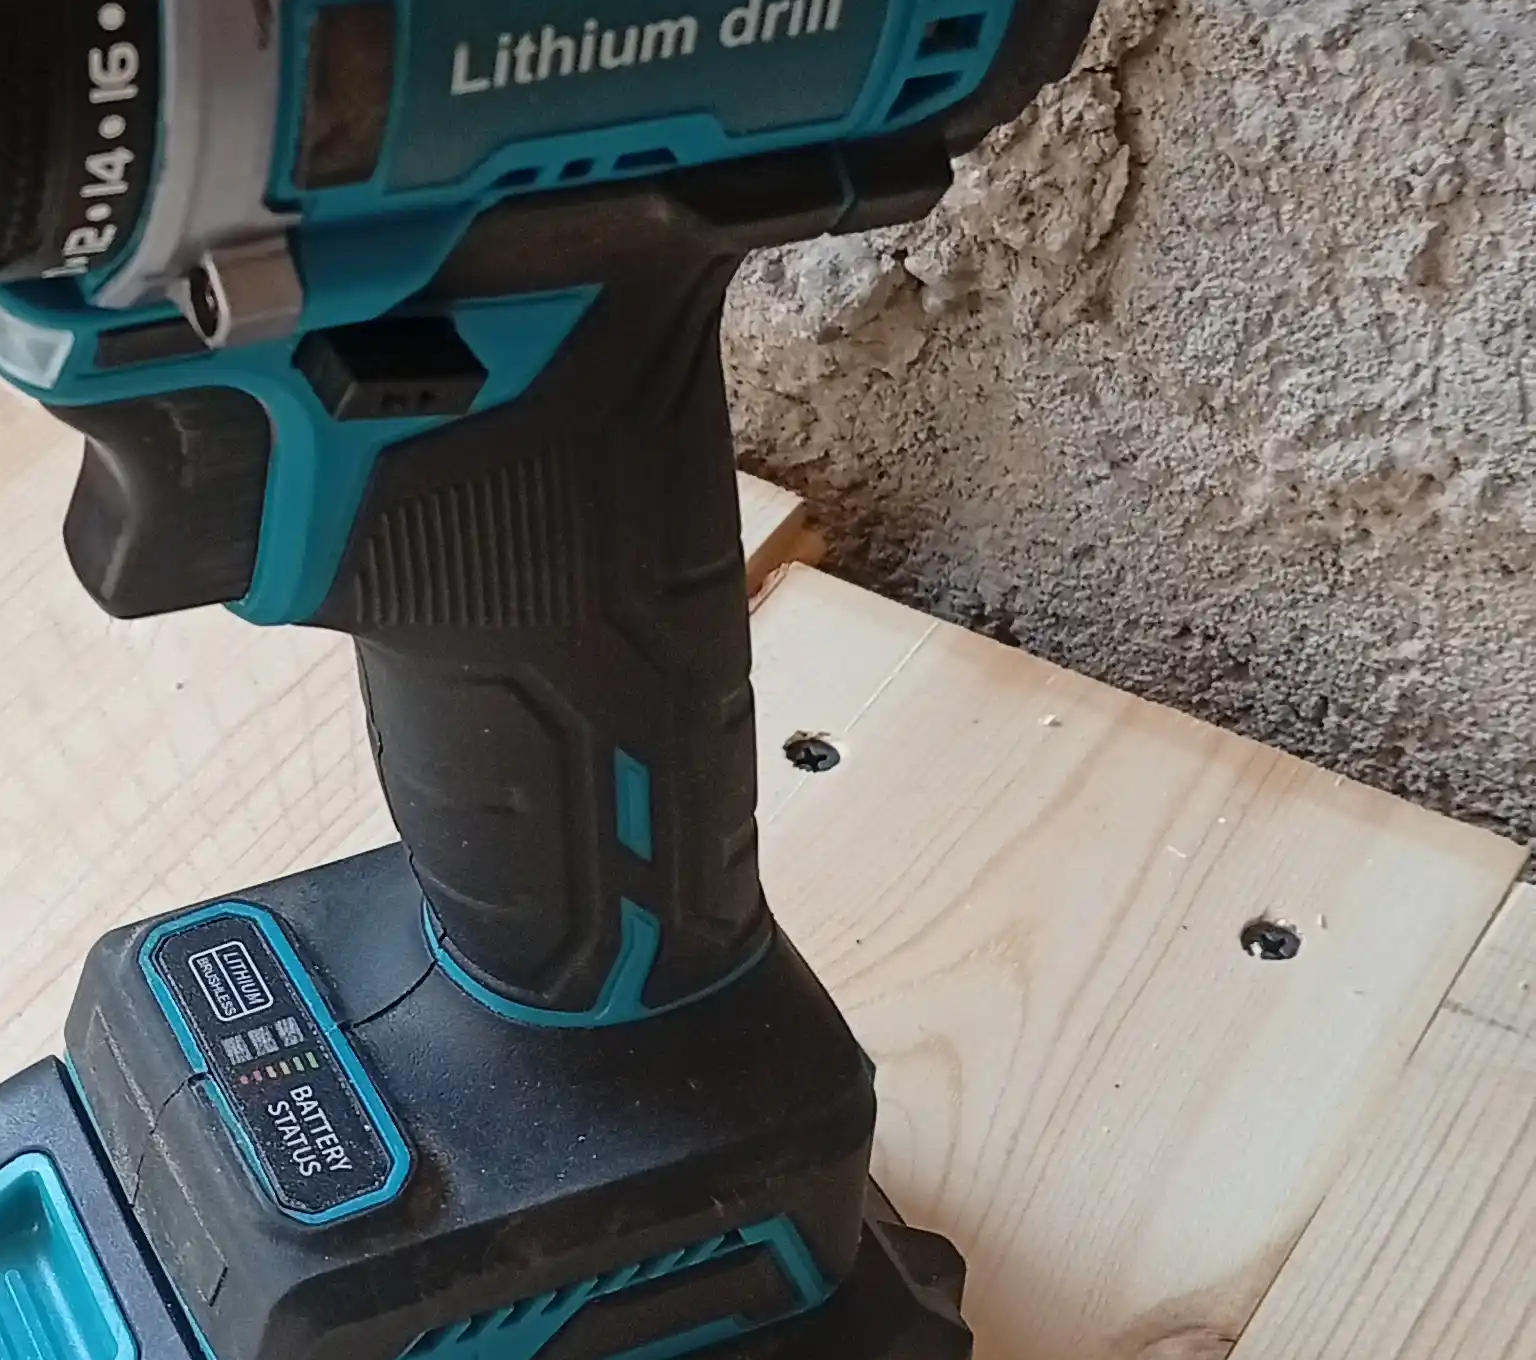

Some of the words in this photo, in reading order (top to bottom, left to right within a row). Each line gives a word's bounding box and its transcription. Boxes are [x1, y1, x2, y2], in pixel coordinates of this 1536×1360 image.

[88, 42, 140, 105] 16
[449, 13, 699, 97] Lithium
[79, 146, 135, 199] 14
[195, 956, 238, 1018] BRUSHLESS
[222, 950, 265, 1007] LITHIUM
[267, 1100, 323, 1178] STATUS
[289, 1084, 354, 1173] BATTERY
